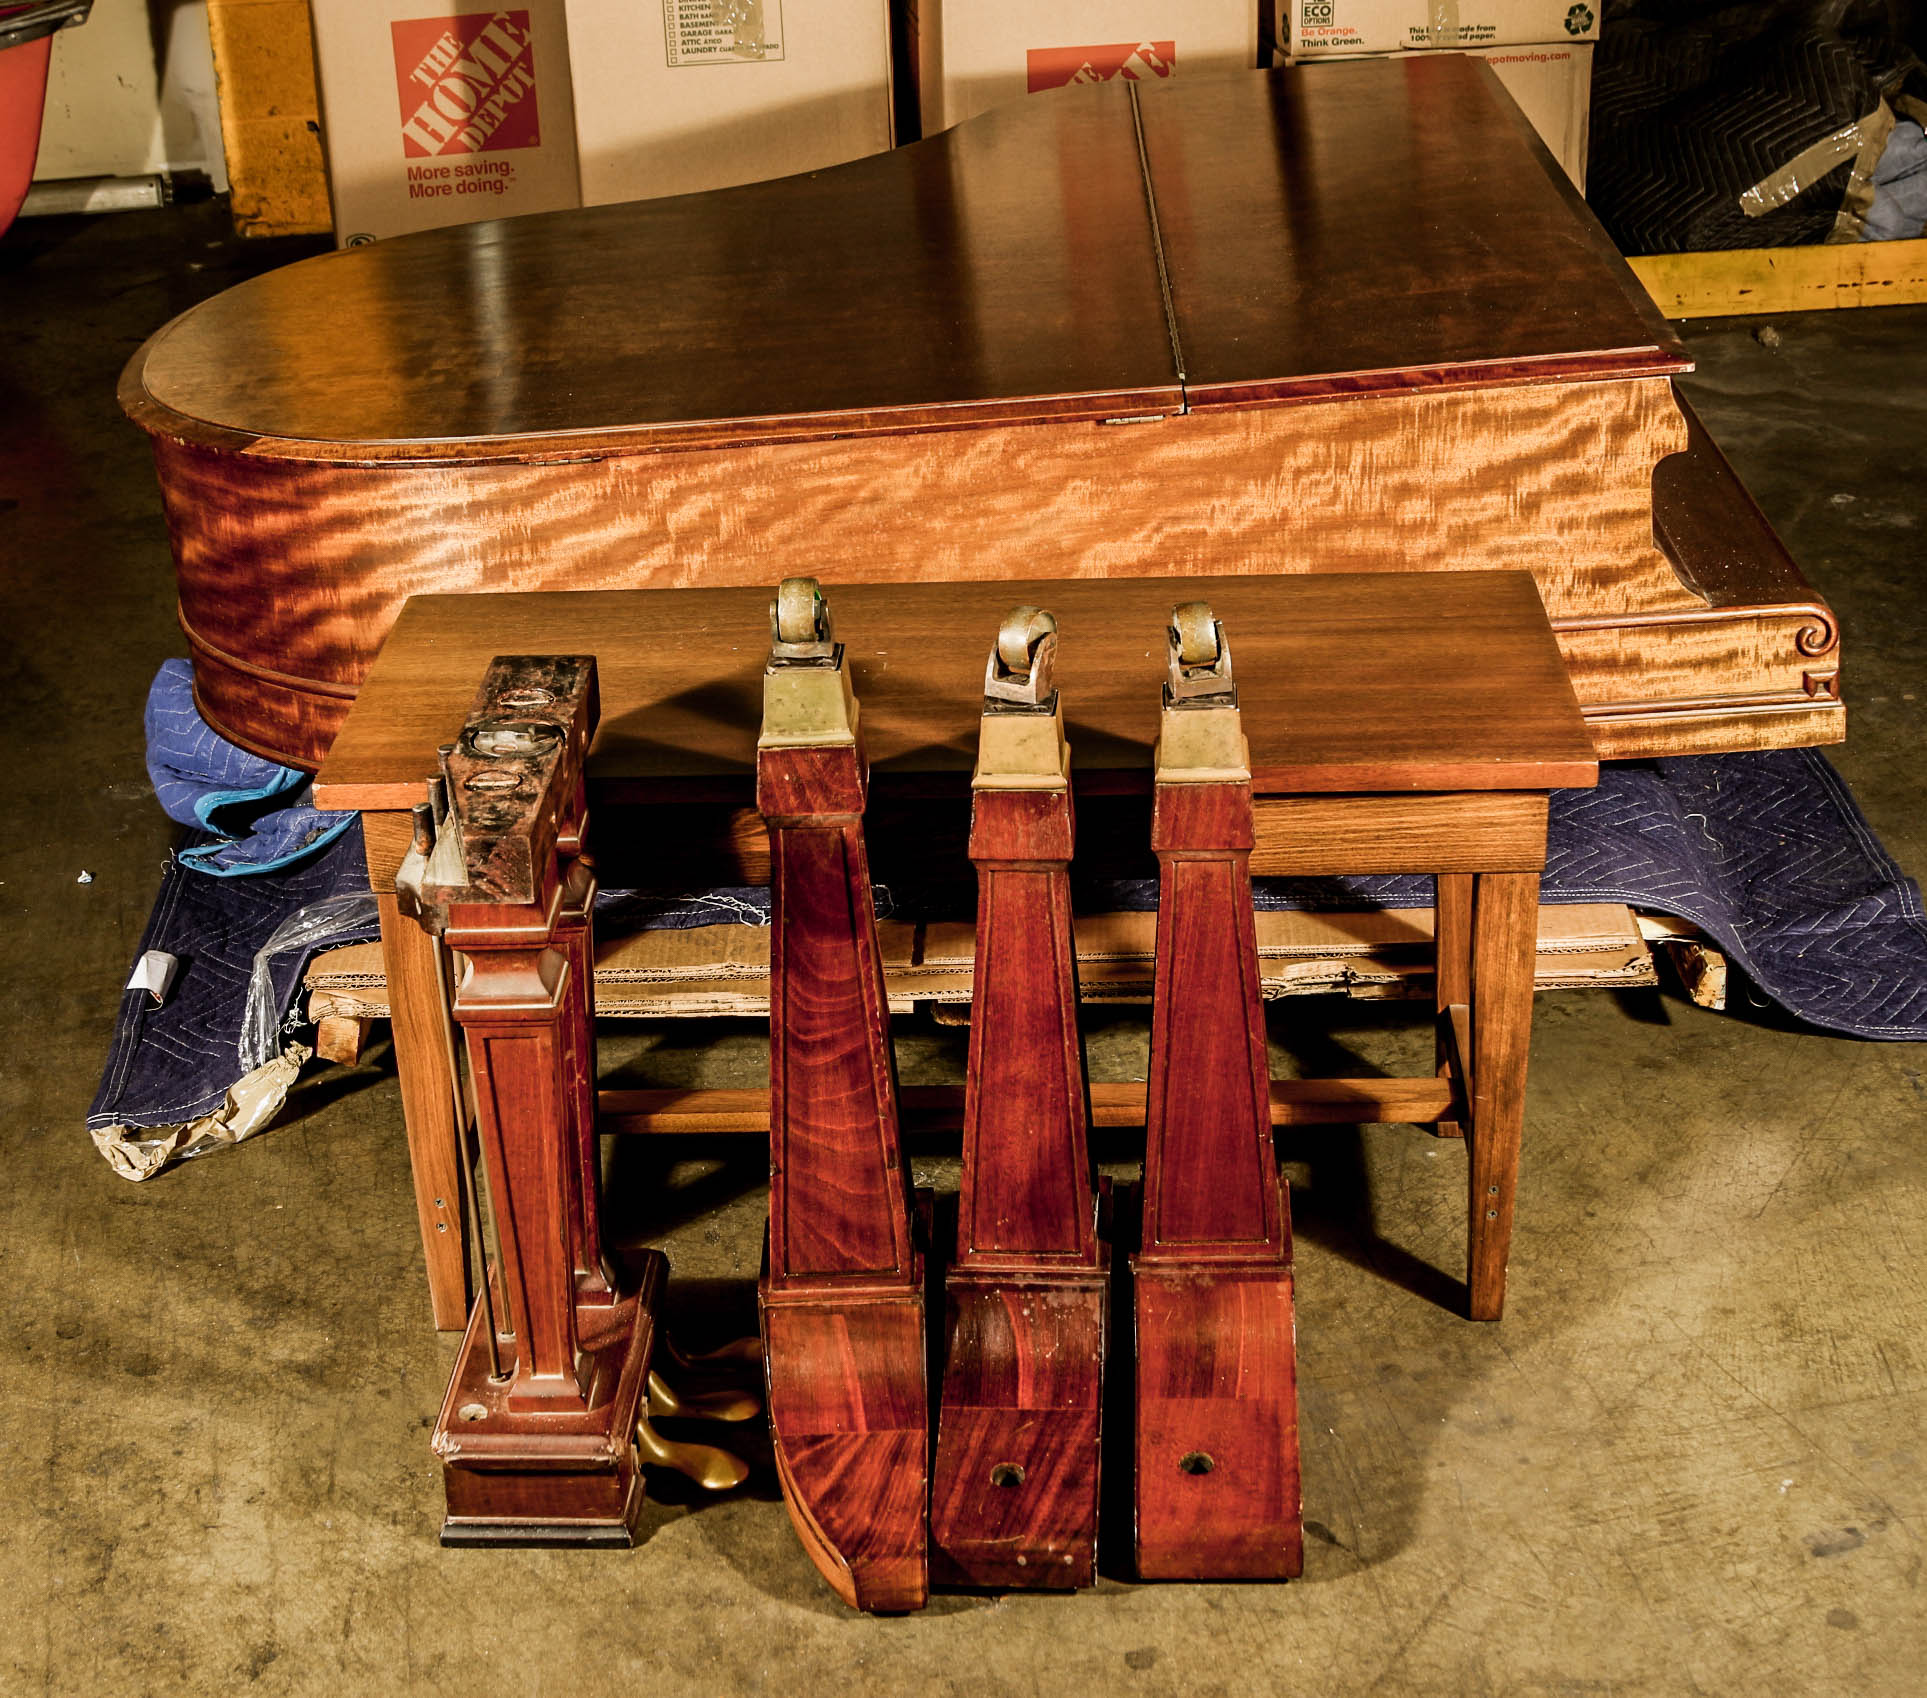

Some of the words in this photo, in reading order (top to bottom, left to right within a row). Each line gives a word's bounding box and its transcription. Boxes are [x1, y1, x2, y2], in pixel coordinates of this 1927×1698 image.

[679, 3, 711, 12] KITCHEN
[1304, 5, 1331, 17] ECO
[679, 12, 699, 20] BATH
[1303, 17, 1330, 25] OPTIONS
[680, 21, 719, 29] BASEMENT
[1409, 26, 1424, 34] This
[1476, 24, 1496, 32] from
[680, 29, 712, 38] GARAGE
[1301, 27, 1315, 37] Be
[1317, 26, 1358, 36] Orange.
[1469, 33, 1496, 41] paper.
[681, 38, 701, 47] ATTIC
[1301, 38, 1329, 48] Think
[1331, 37, 1365, 47] Green.
[681, 46, 718, 55] LAUNDRY
[409, 31, 464, 88] THE
[1485, 51, 1571, 65] epotmoving.com
[402, 12, 534, 157] HOME
[456, 61, 535, 152] DEPOT
[407, 166, 450, 182] More
[454, 159, 515, 177] saving.
[409, 183, 453, 199] More
[456, 177, 509, 195] doing.
